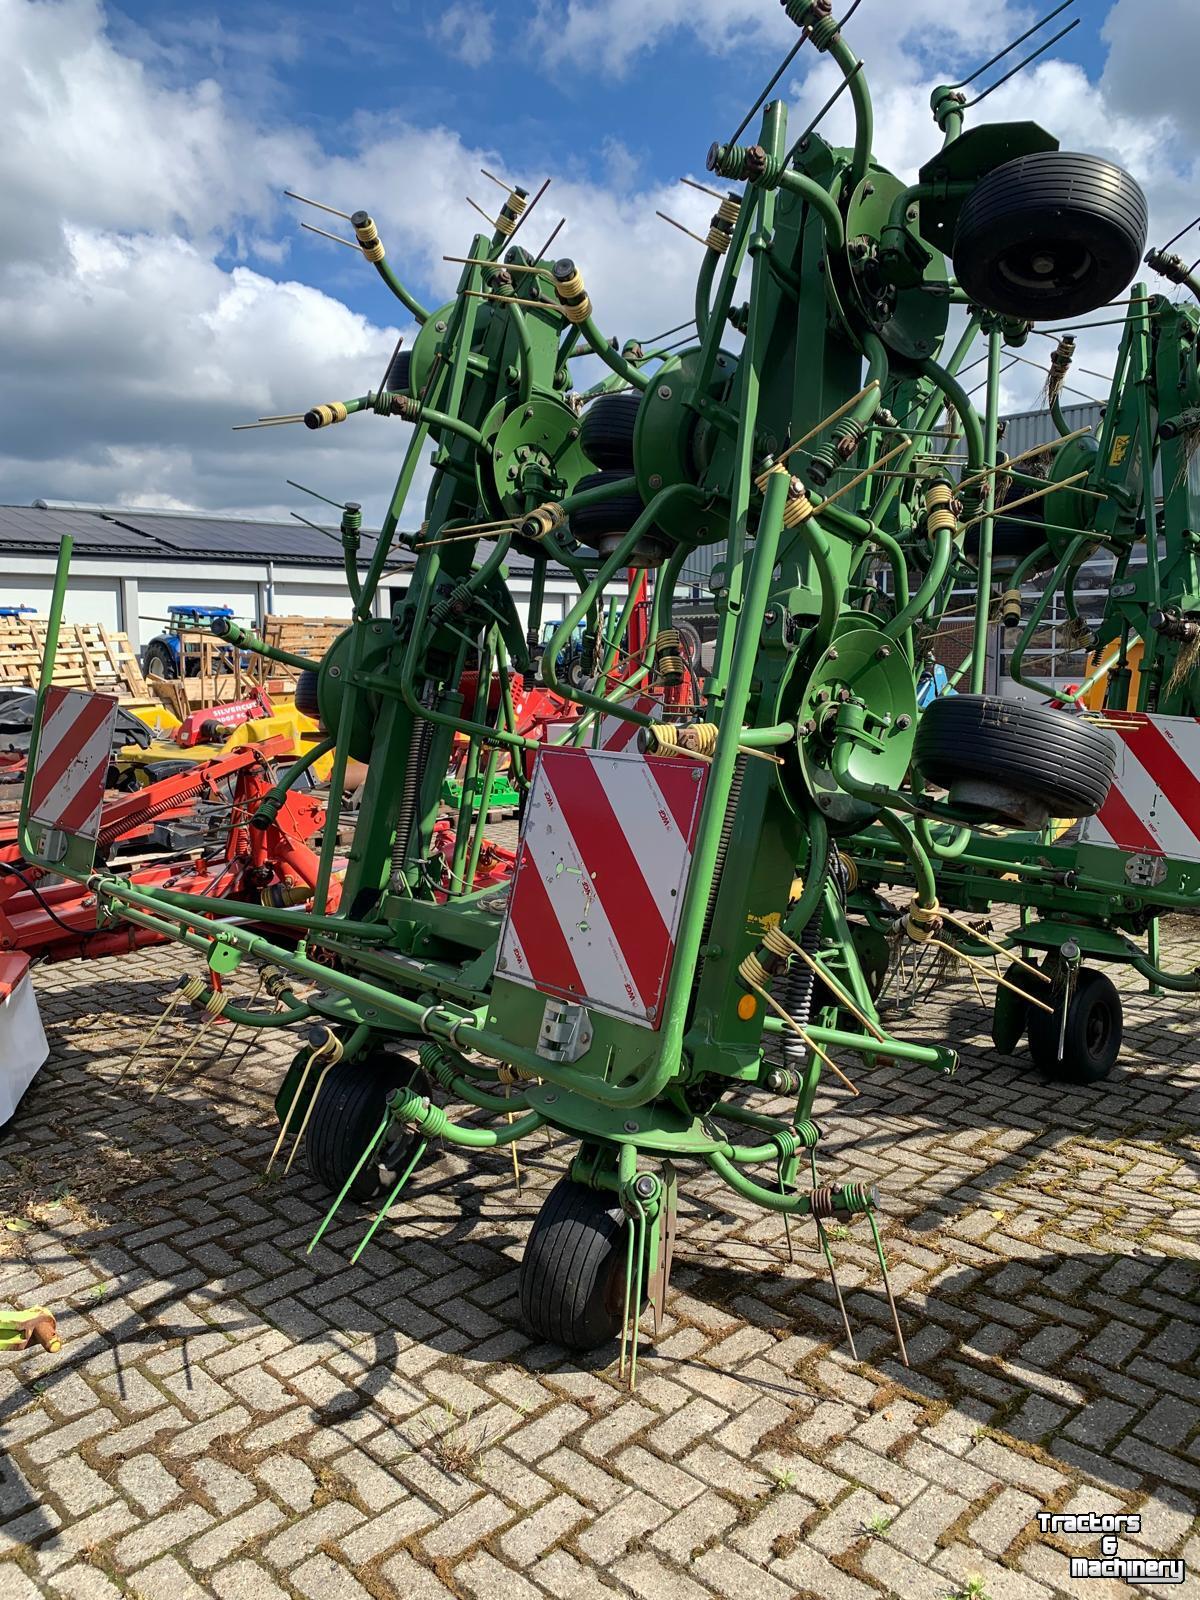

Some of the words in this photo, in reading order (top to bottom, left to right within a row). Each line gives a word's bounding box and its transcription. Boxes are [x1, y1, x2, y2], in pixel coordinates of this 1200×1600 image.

[213, 700, 257, 717] SILVERCUT
[544, 791, 554, 808] WGF
[658, 809, 671, 827] WGF
[513, 947, 523, 965] WGF
[624, 983, 637, 1003] WGF
